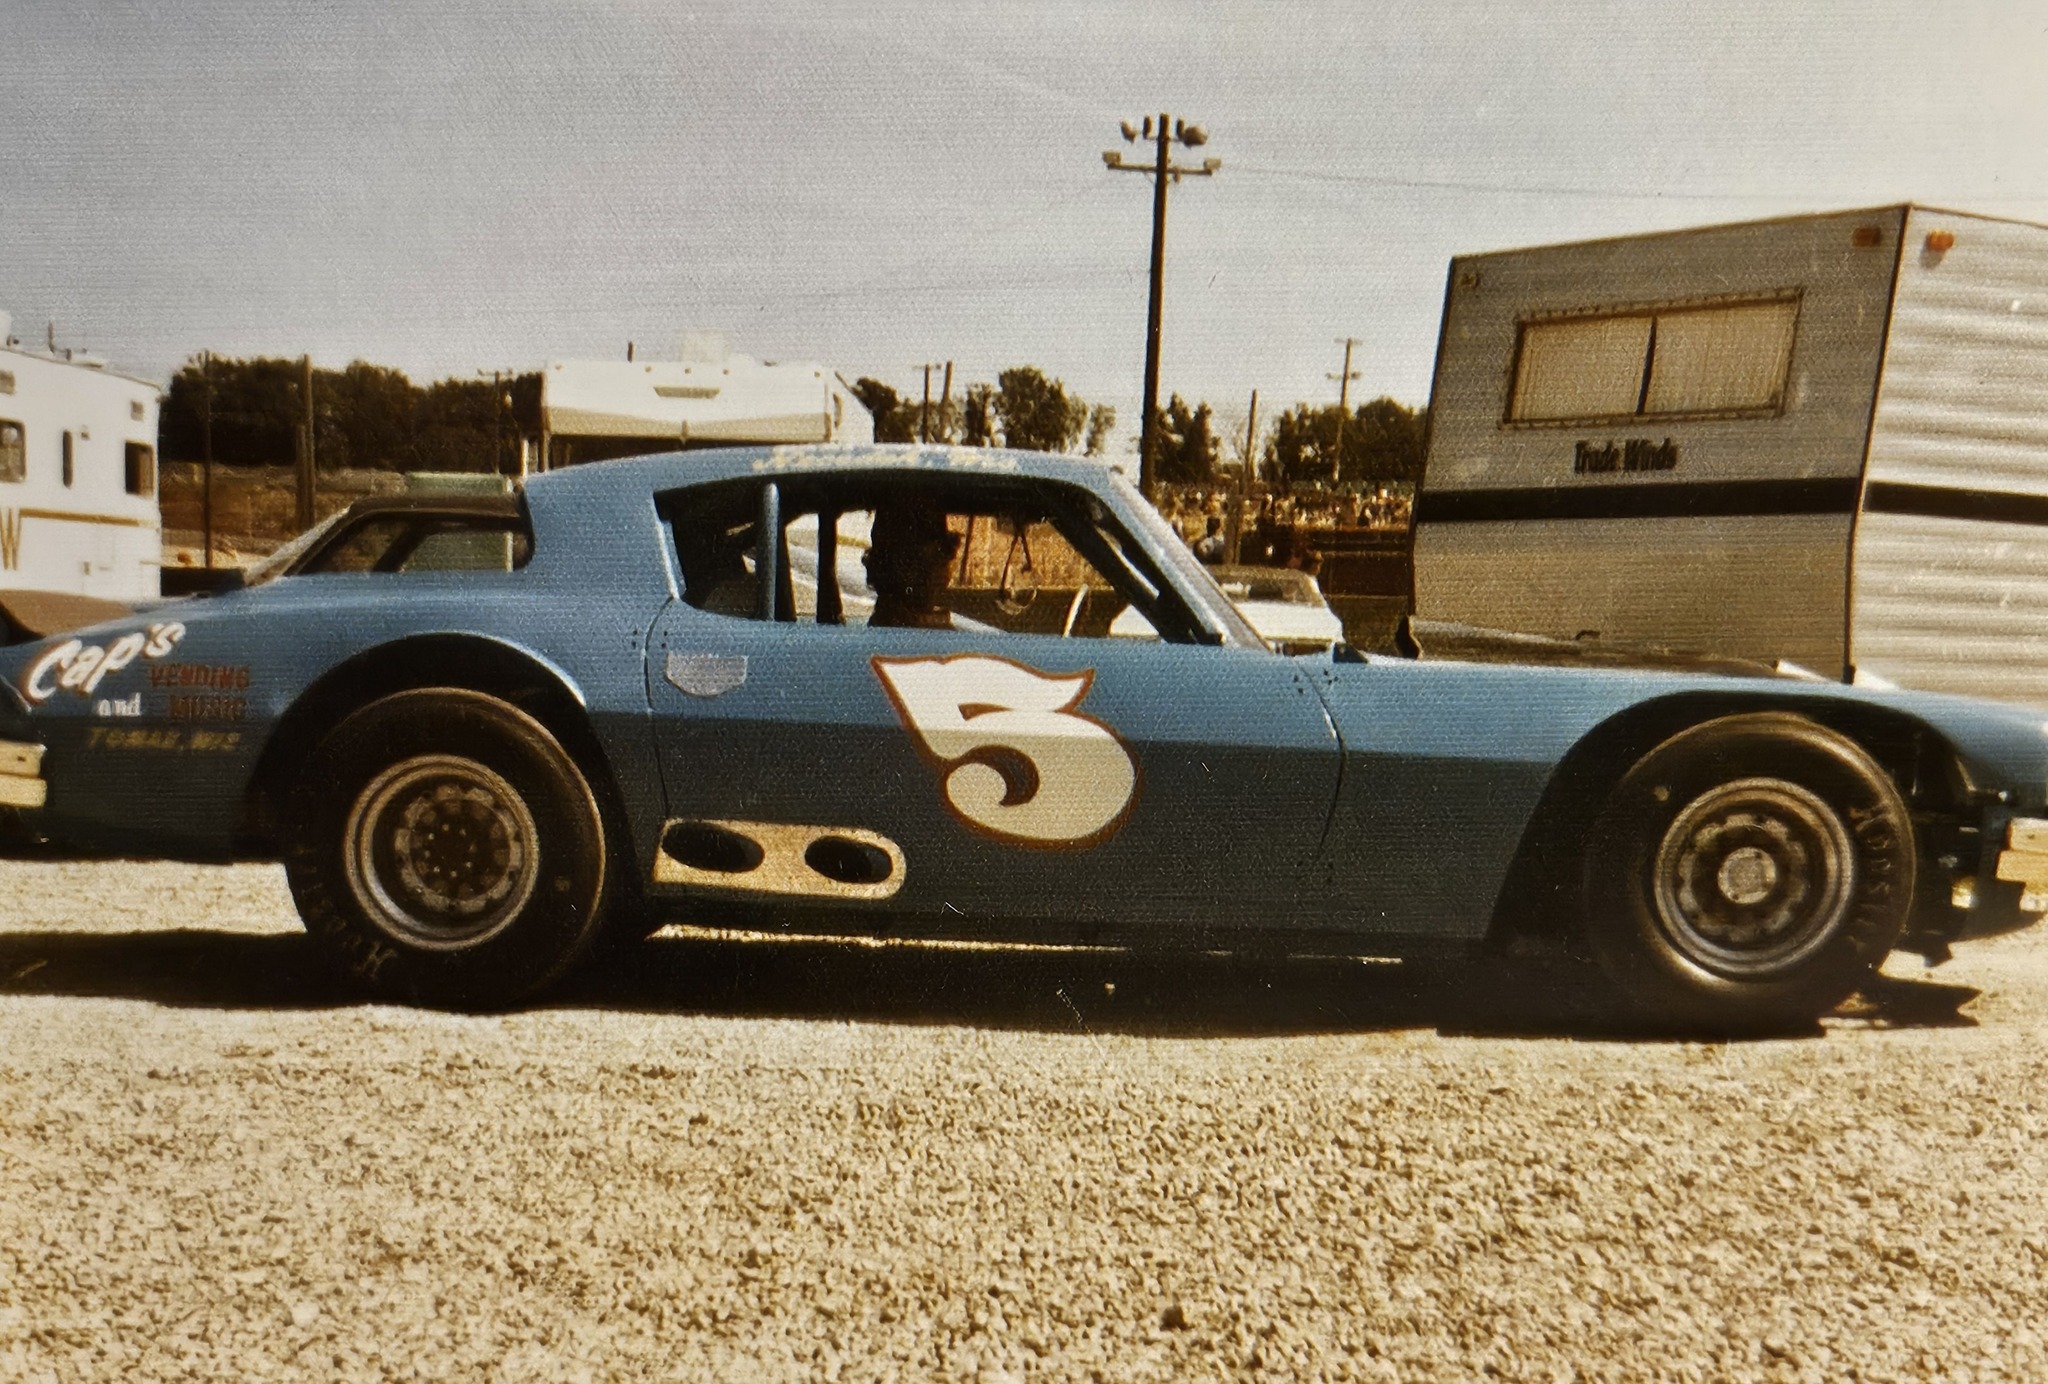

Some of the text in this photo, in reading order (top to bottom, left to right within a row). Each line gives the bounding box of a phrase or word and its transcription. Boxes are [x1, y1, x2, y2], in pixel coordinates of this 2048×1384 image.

[19, 622, 186, 705] Cap's
[97, 692, 141, 717] and
[871, 653, 1142, 848] 5
